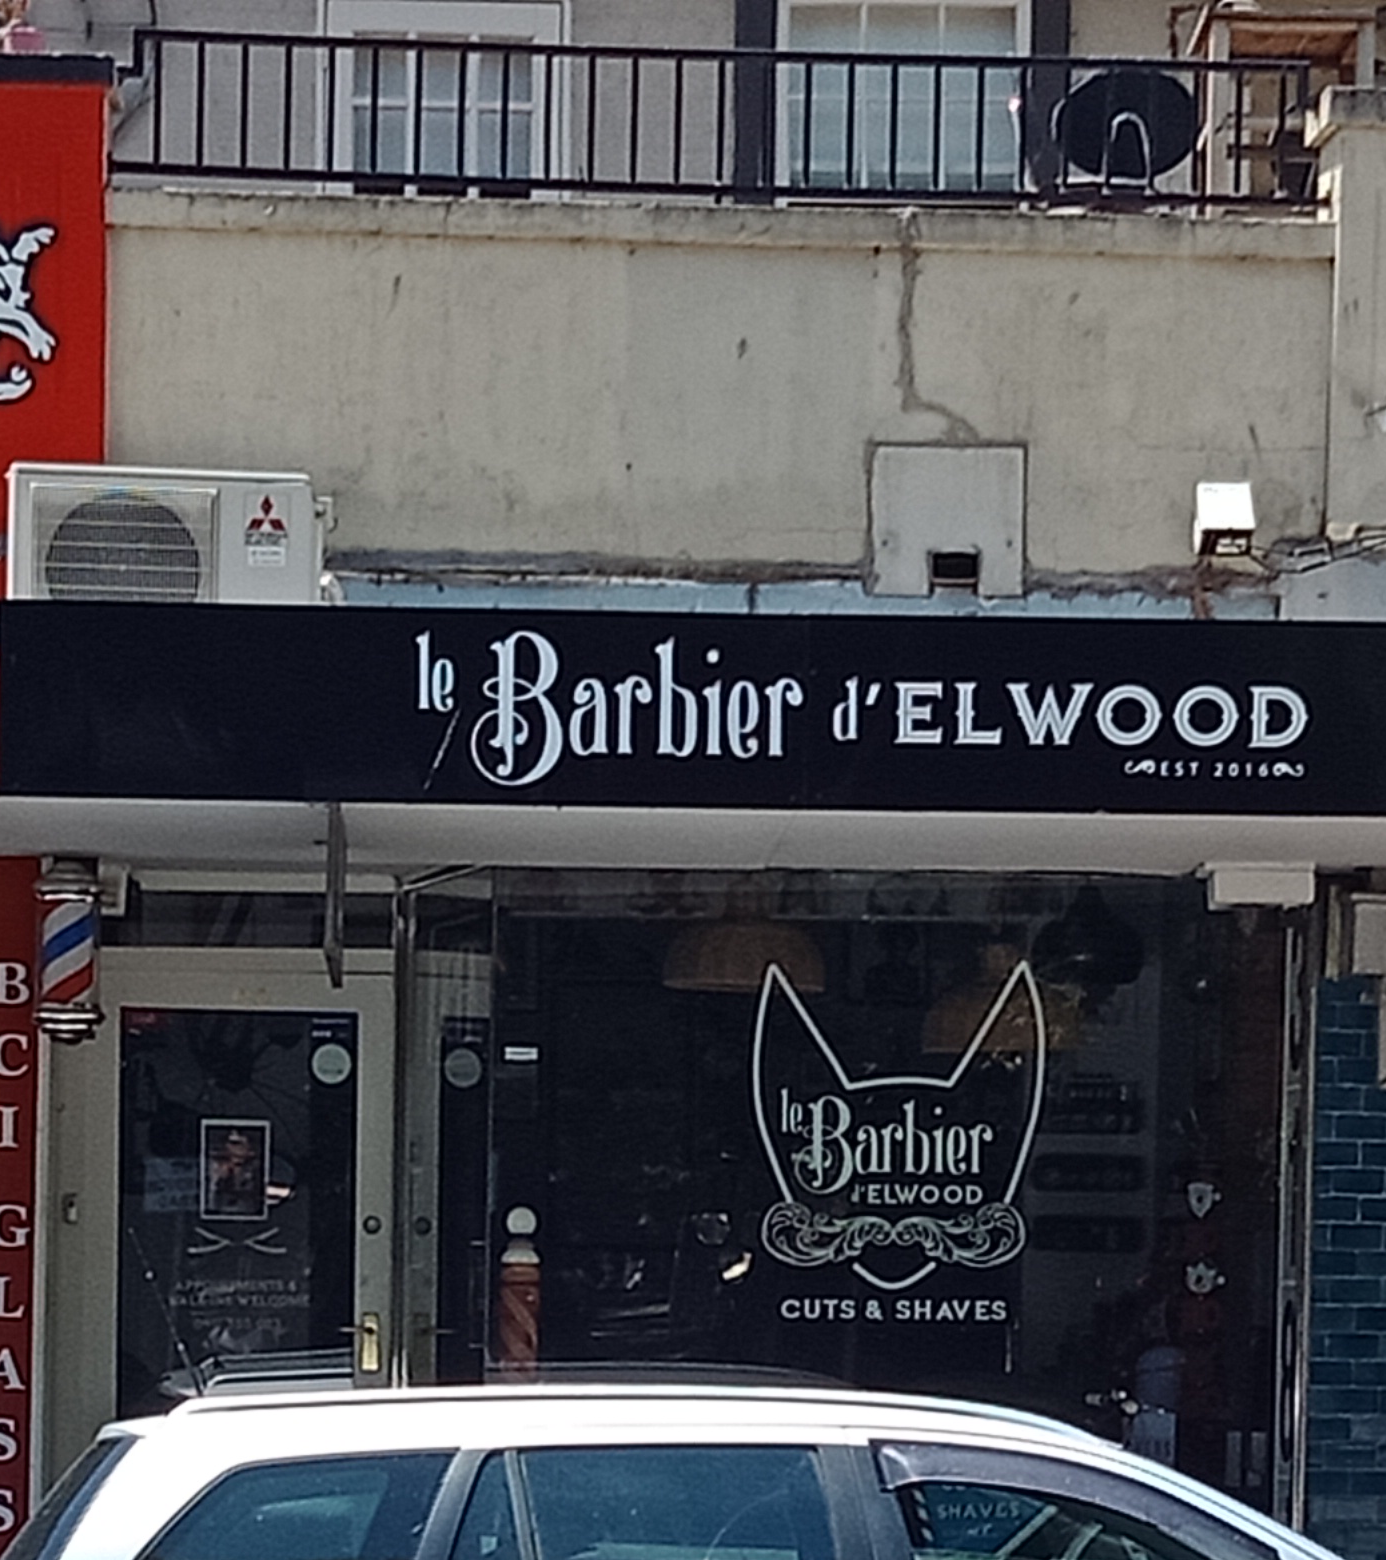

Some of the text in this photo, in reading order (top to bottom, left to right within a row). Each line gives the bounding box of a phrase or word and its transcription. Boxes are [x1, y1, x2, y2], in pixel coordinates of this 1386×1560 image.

[416, 629, 1310, 786] le Barbier d'ELWOOD
[1160, 760, 1200, 777] EST
[780, 1088, 993, 1195] le Barbier
[780, 1299, 1007, 1322] CUTS & SHAVES
[936, 1501, 1021, 1520] SHAVES
